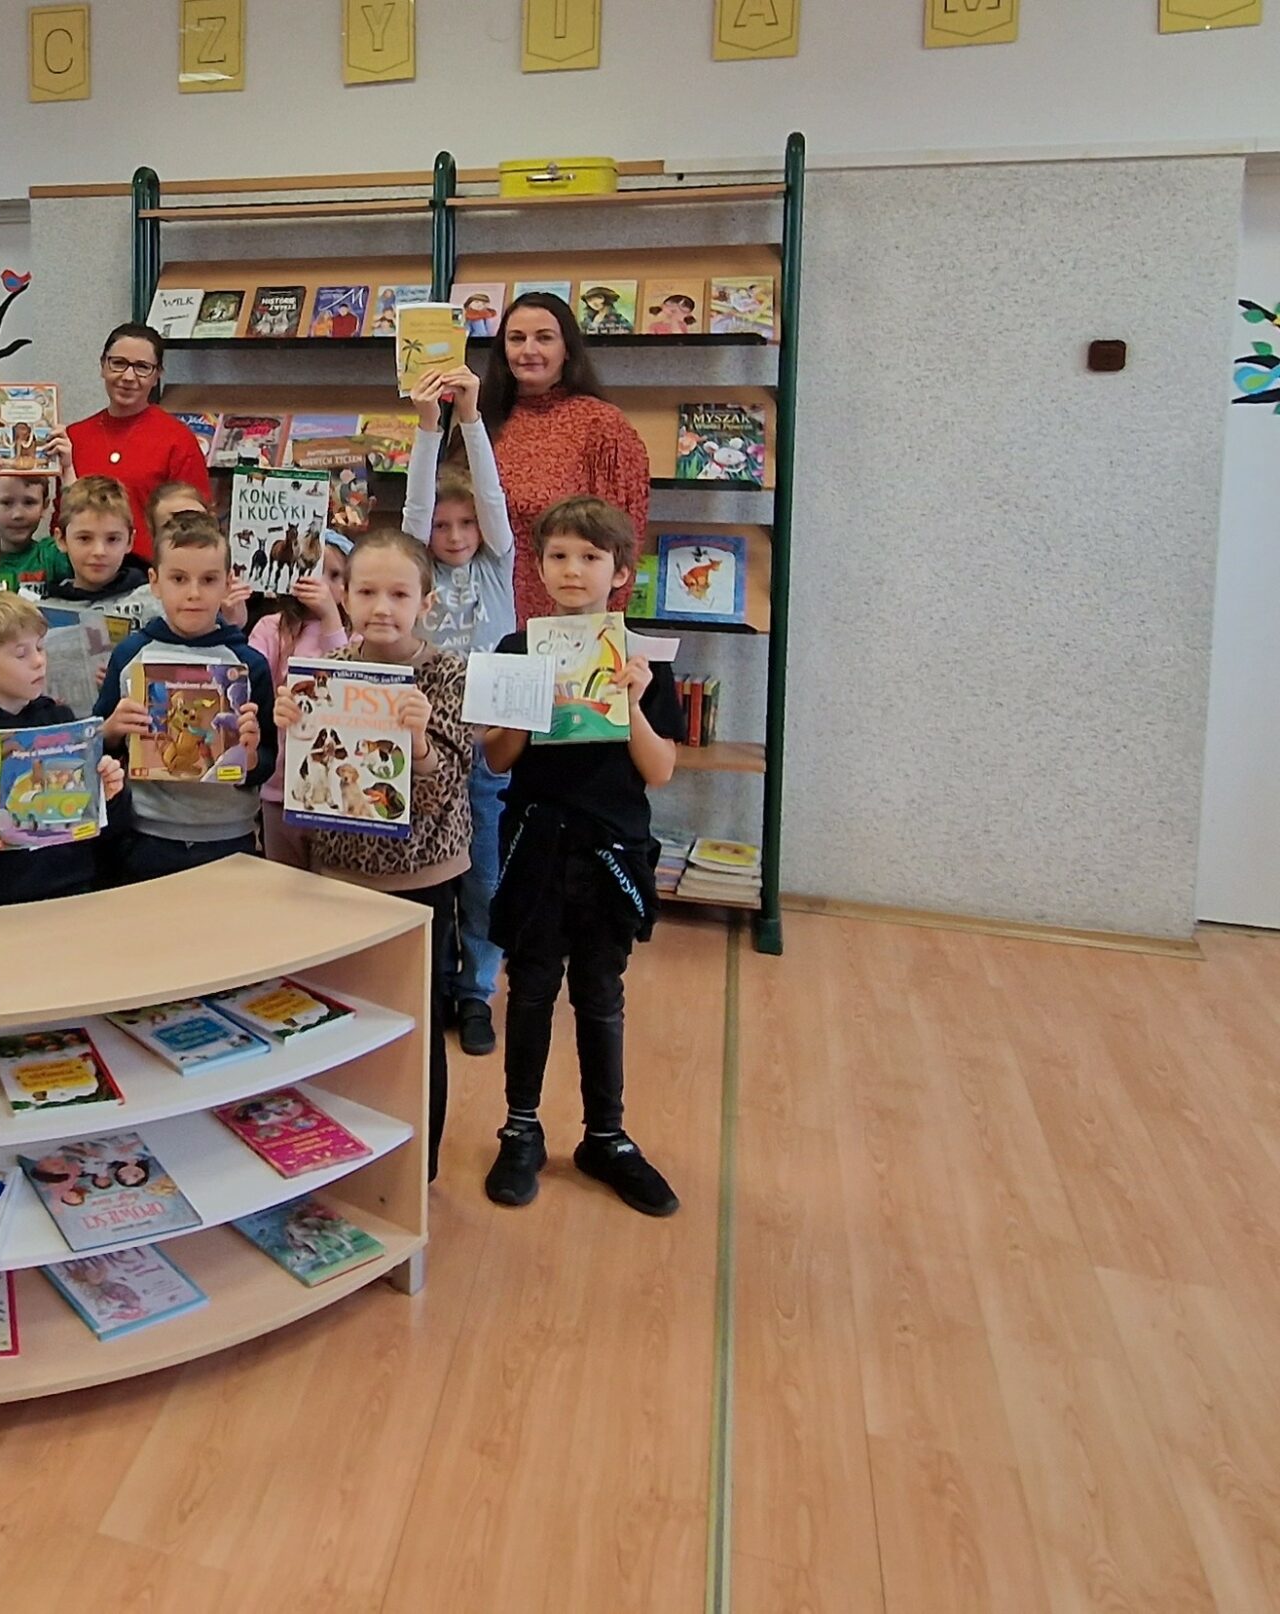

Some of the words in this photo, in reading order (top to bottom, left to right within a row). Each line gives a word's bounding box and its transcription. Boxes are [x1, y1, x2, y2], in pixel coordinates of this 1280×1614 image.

[196, 16, 228, 64] Z
[162, 296, 194, 307] WILK
[693, 413, 750, 424] MYSZAK
[422, 607, 490, 632] CALM
[440, 636, 470, 647] AND
[342, 685, 403, 715] PSY
